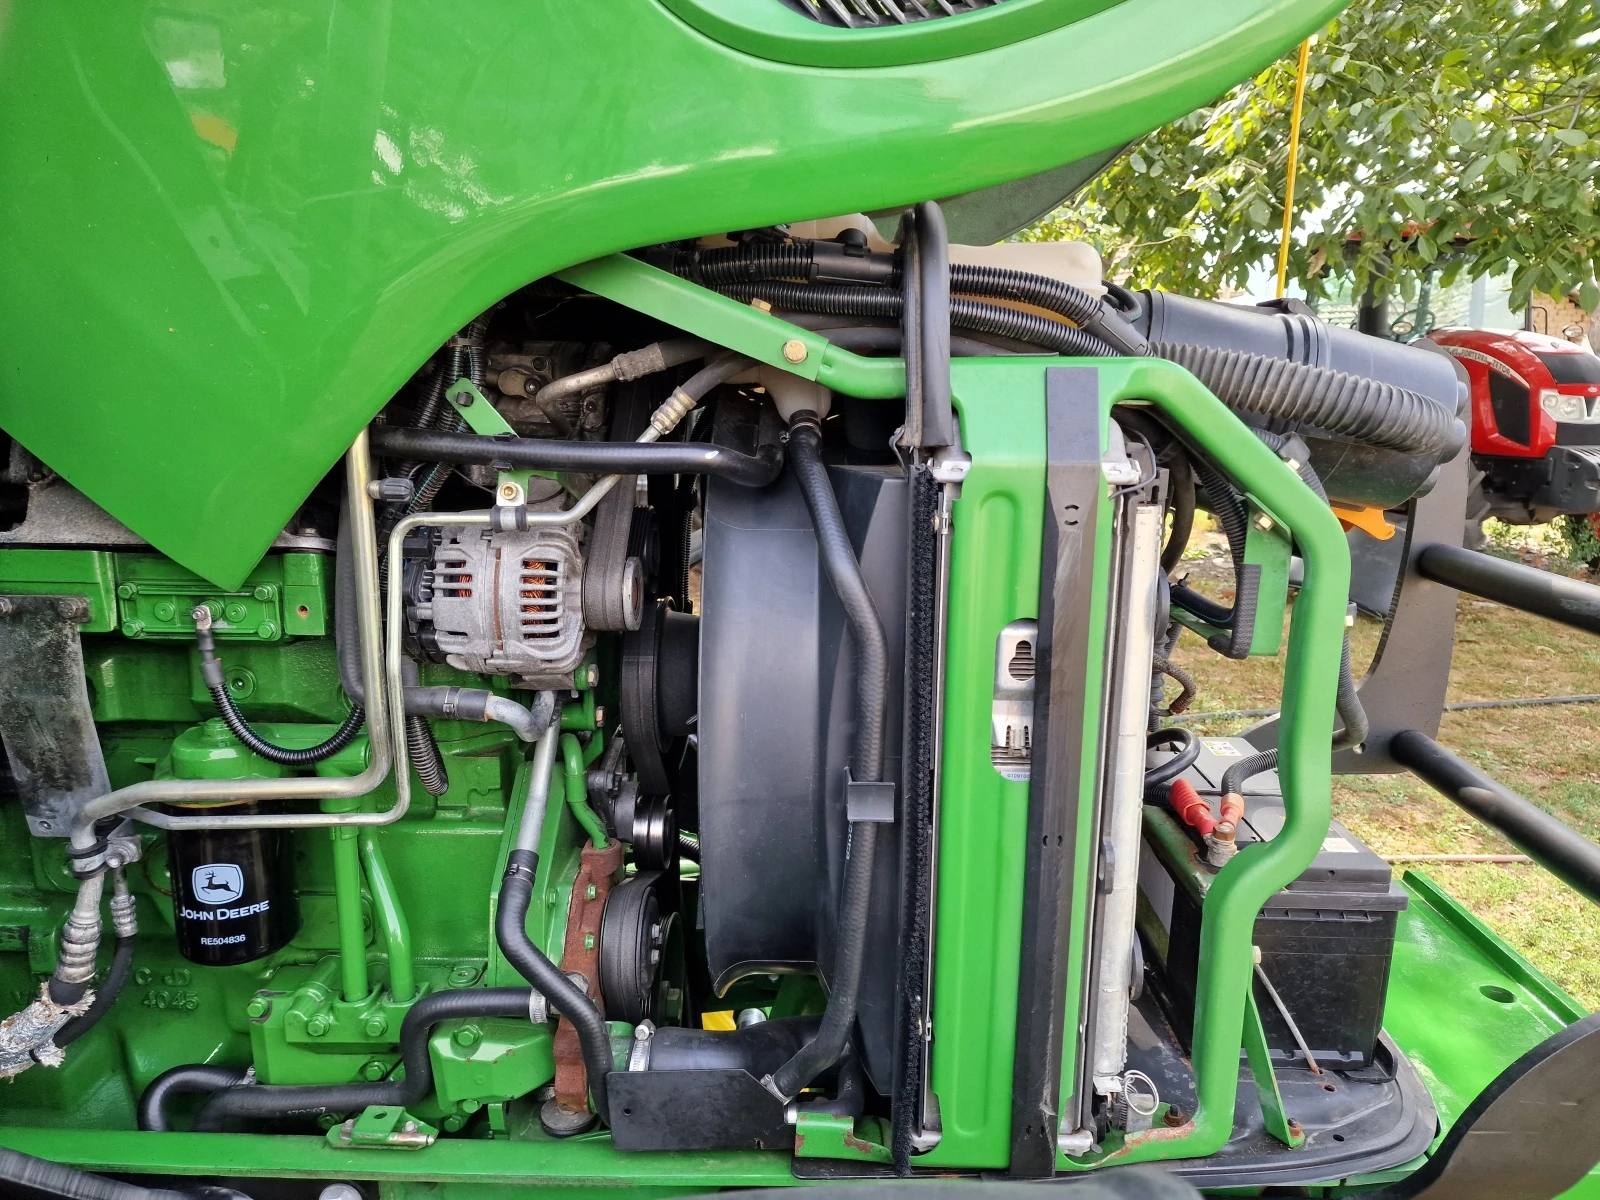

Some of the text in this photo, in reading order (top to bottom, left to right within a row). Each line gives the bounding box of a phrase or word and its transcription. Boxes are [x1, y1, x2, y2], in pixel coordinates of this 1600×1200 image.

[1461, 349, 1488, 364] FORTERRA
[1492, 359, 1511, 376] ZETOR
[180, 900, 270, 921] JOHN DEERE
[200, 934, 246, 946] RE504836
[142, 990, 199, 1010] 4045
